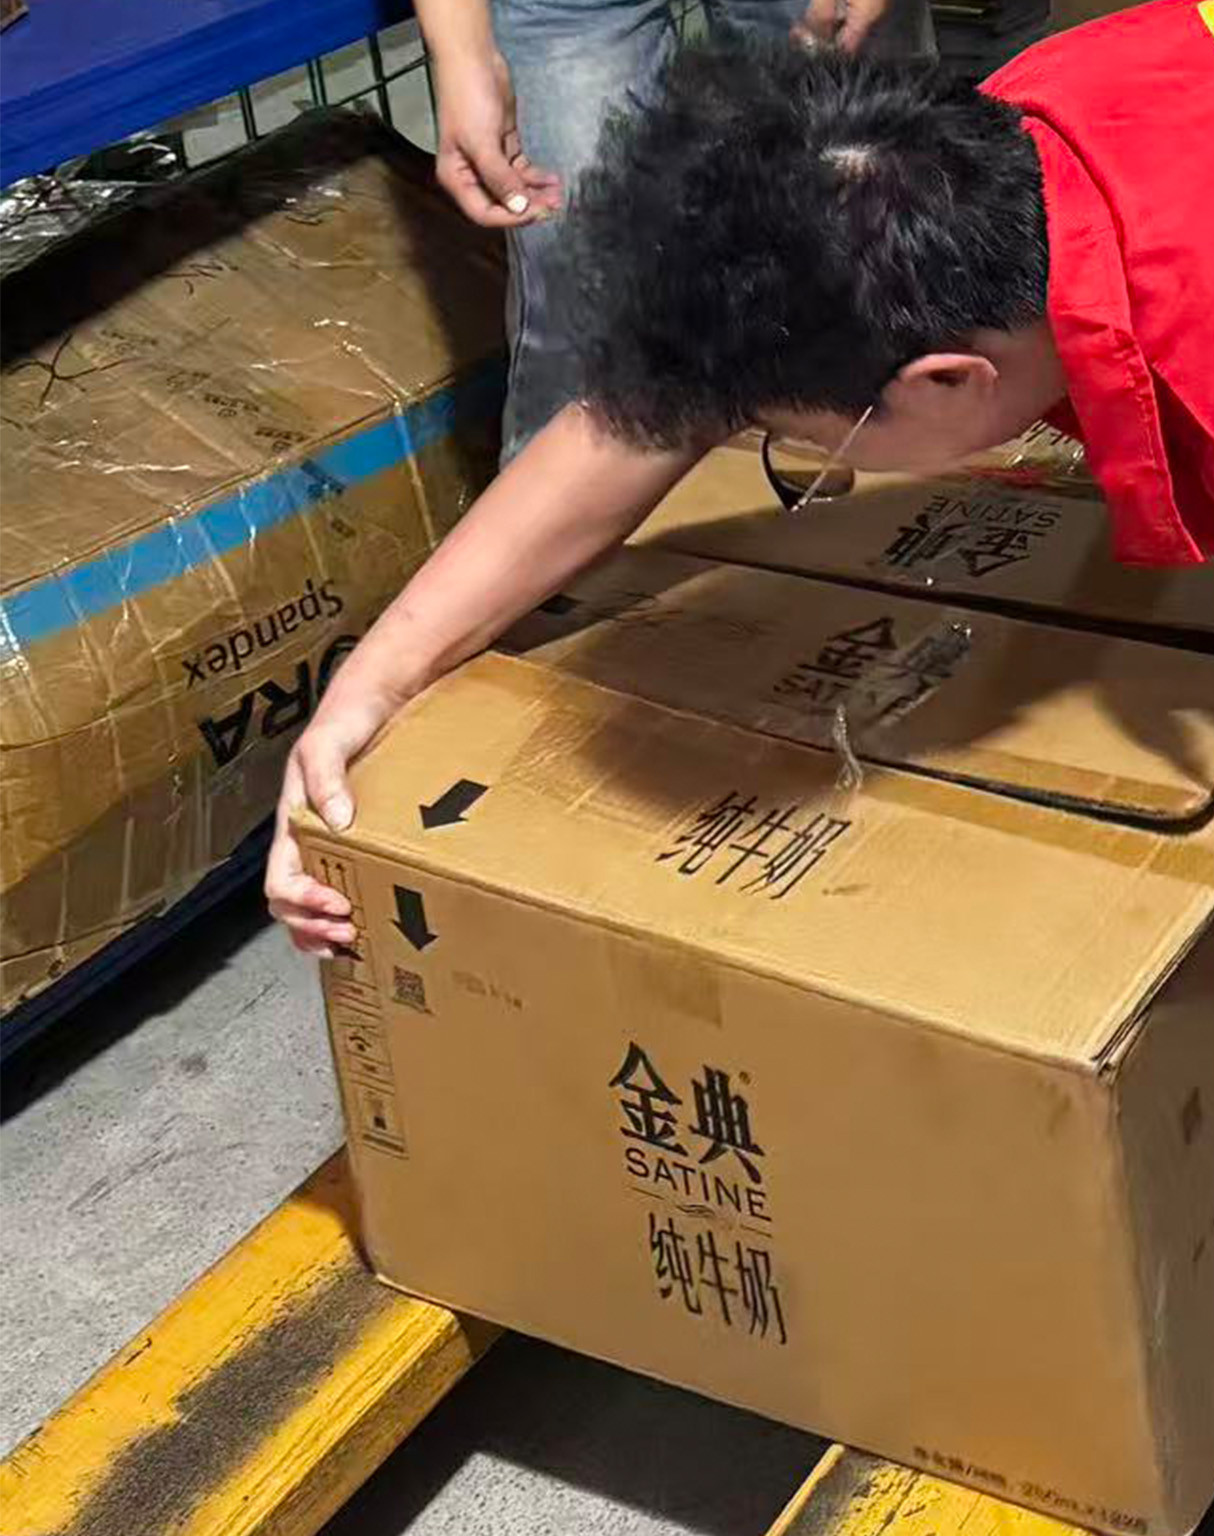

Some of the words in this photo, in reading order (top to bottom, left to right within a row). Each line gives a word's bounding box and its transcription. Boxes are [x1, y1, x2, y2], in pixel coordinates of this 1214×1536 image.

[924, 495, 1061, 527] SATINE
[182, 579, 344, 691] Spandex
[654, 791, 852, 899] 纯牛奶
[608, 1040, 765, 1184] 金典
[625, 1147, 772, 1222] SATINE
[648, 1212, 787, 1345] 纯牛奶
